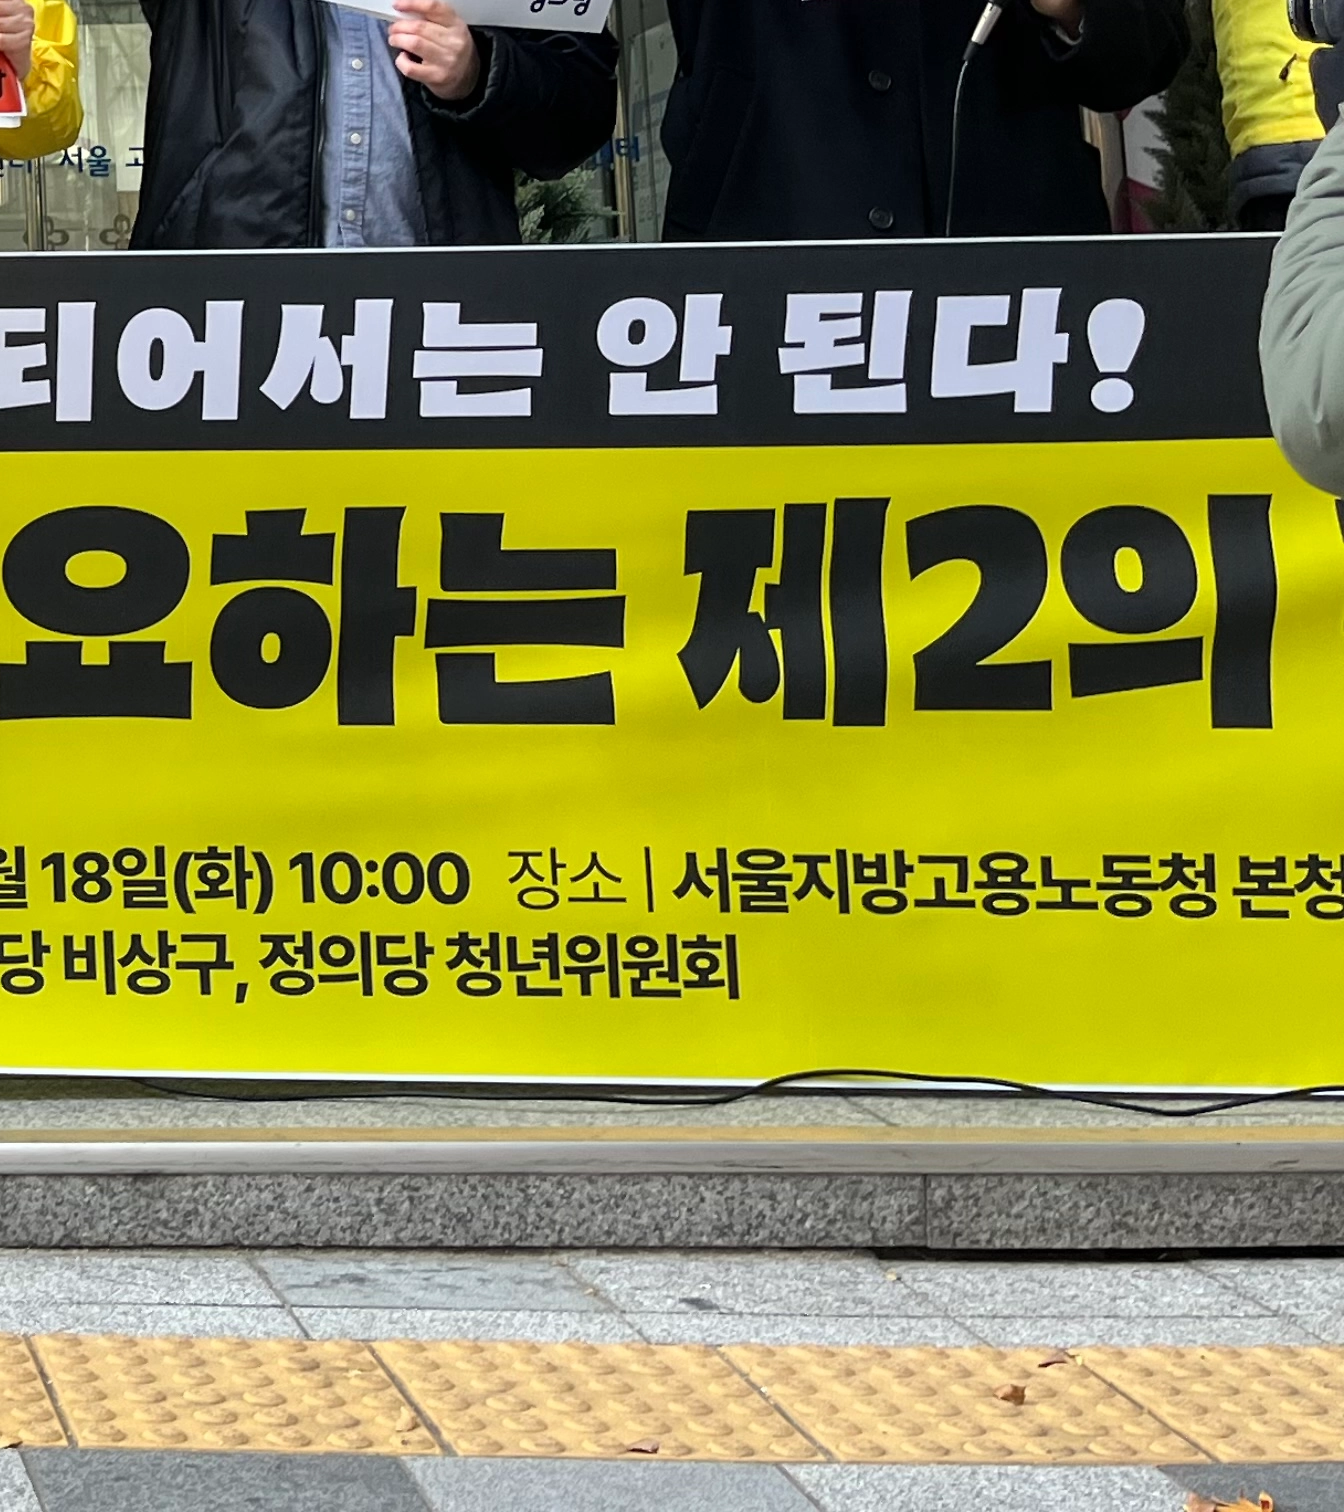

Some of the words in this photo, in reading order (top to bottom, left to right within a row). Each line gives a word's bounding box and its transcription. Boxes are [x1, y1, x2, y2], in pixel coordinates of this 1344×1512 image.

[59, 145, 111, 178] 서울
[595, 291, 733, 418] 안
[777, 284, 1149, 414] 된다!
[678, 492, 1278, 730] 제2의
[39, 844, 275, 915] 18일(화)
[288, 850, 471, 905] 10:00
[505, 847, 626, 910] 장소
[672, 847, 1218, 919] 서울지방고용노동청
[1232, 852, 1344, 919] 본청
[63, 929, 249, 1005] 비상구,
[258, 930, 433, 999] 정의당
[444, 930, 741, 1000] 청년위원회
